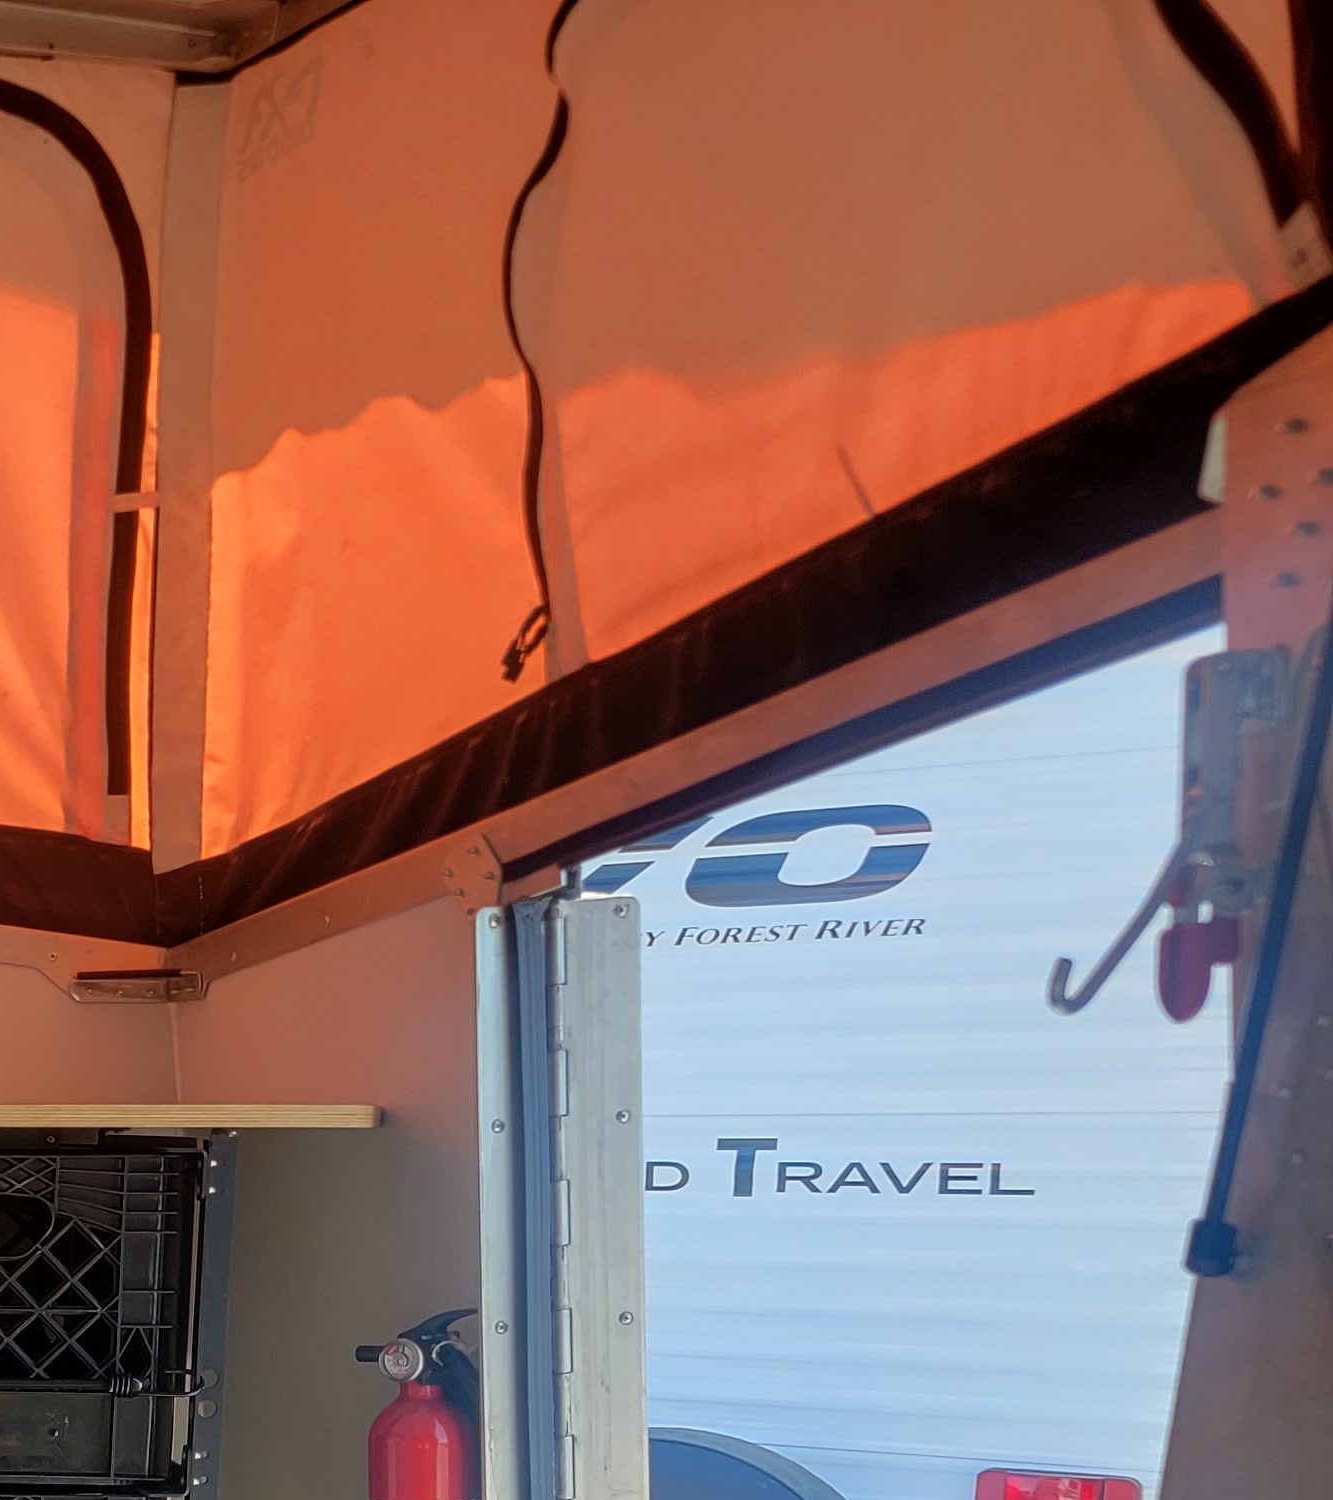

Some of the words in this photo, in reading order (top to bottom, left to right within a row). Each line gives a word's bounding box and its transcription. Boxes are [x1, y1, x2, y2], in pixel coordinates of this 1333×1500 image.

[674, 924, 808, 947] FOREST
[814, 918, 927, 940] RIVER
[716, 1138, 1035, 1197] TRAVEL
